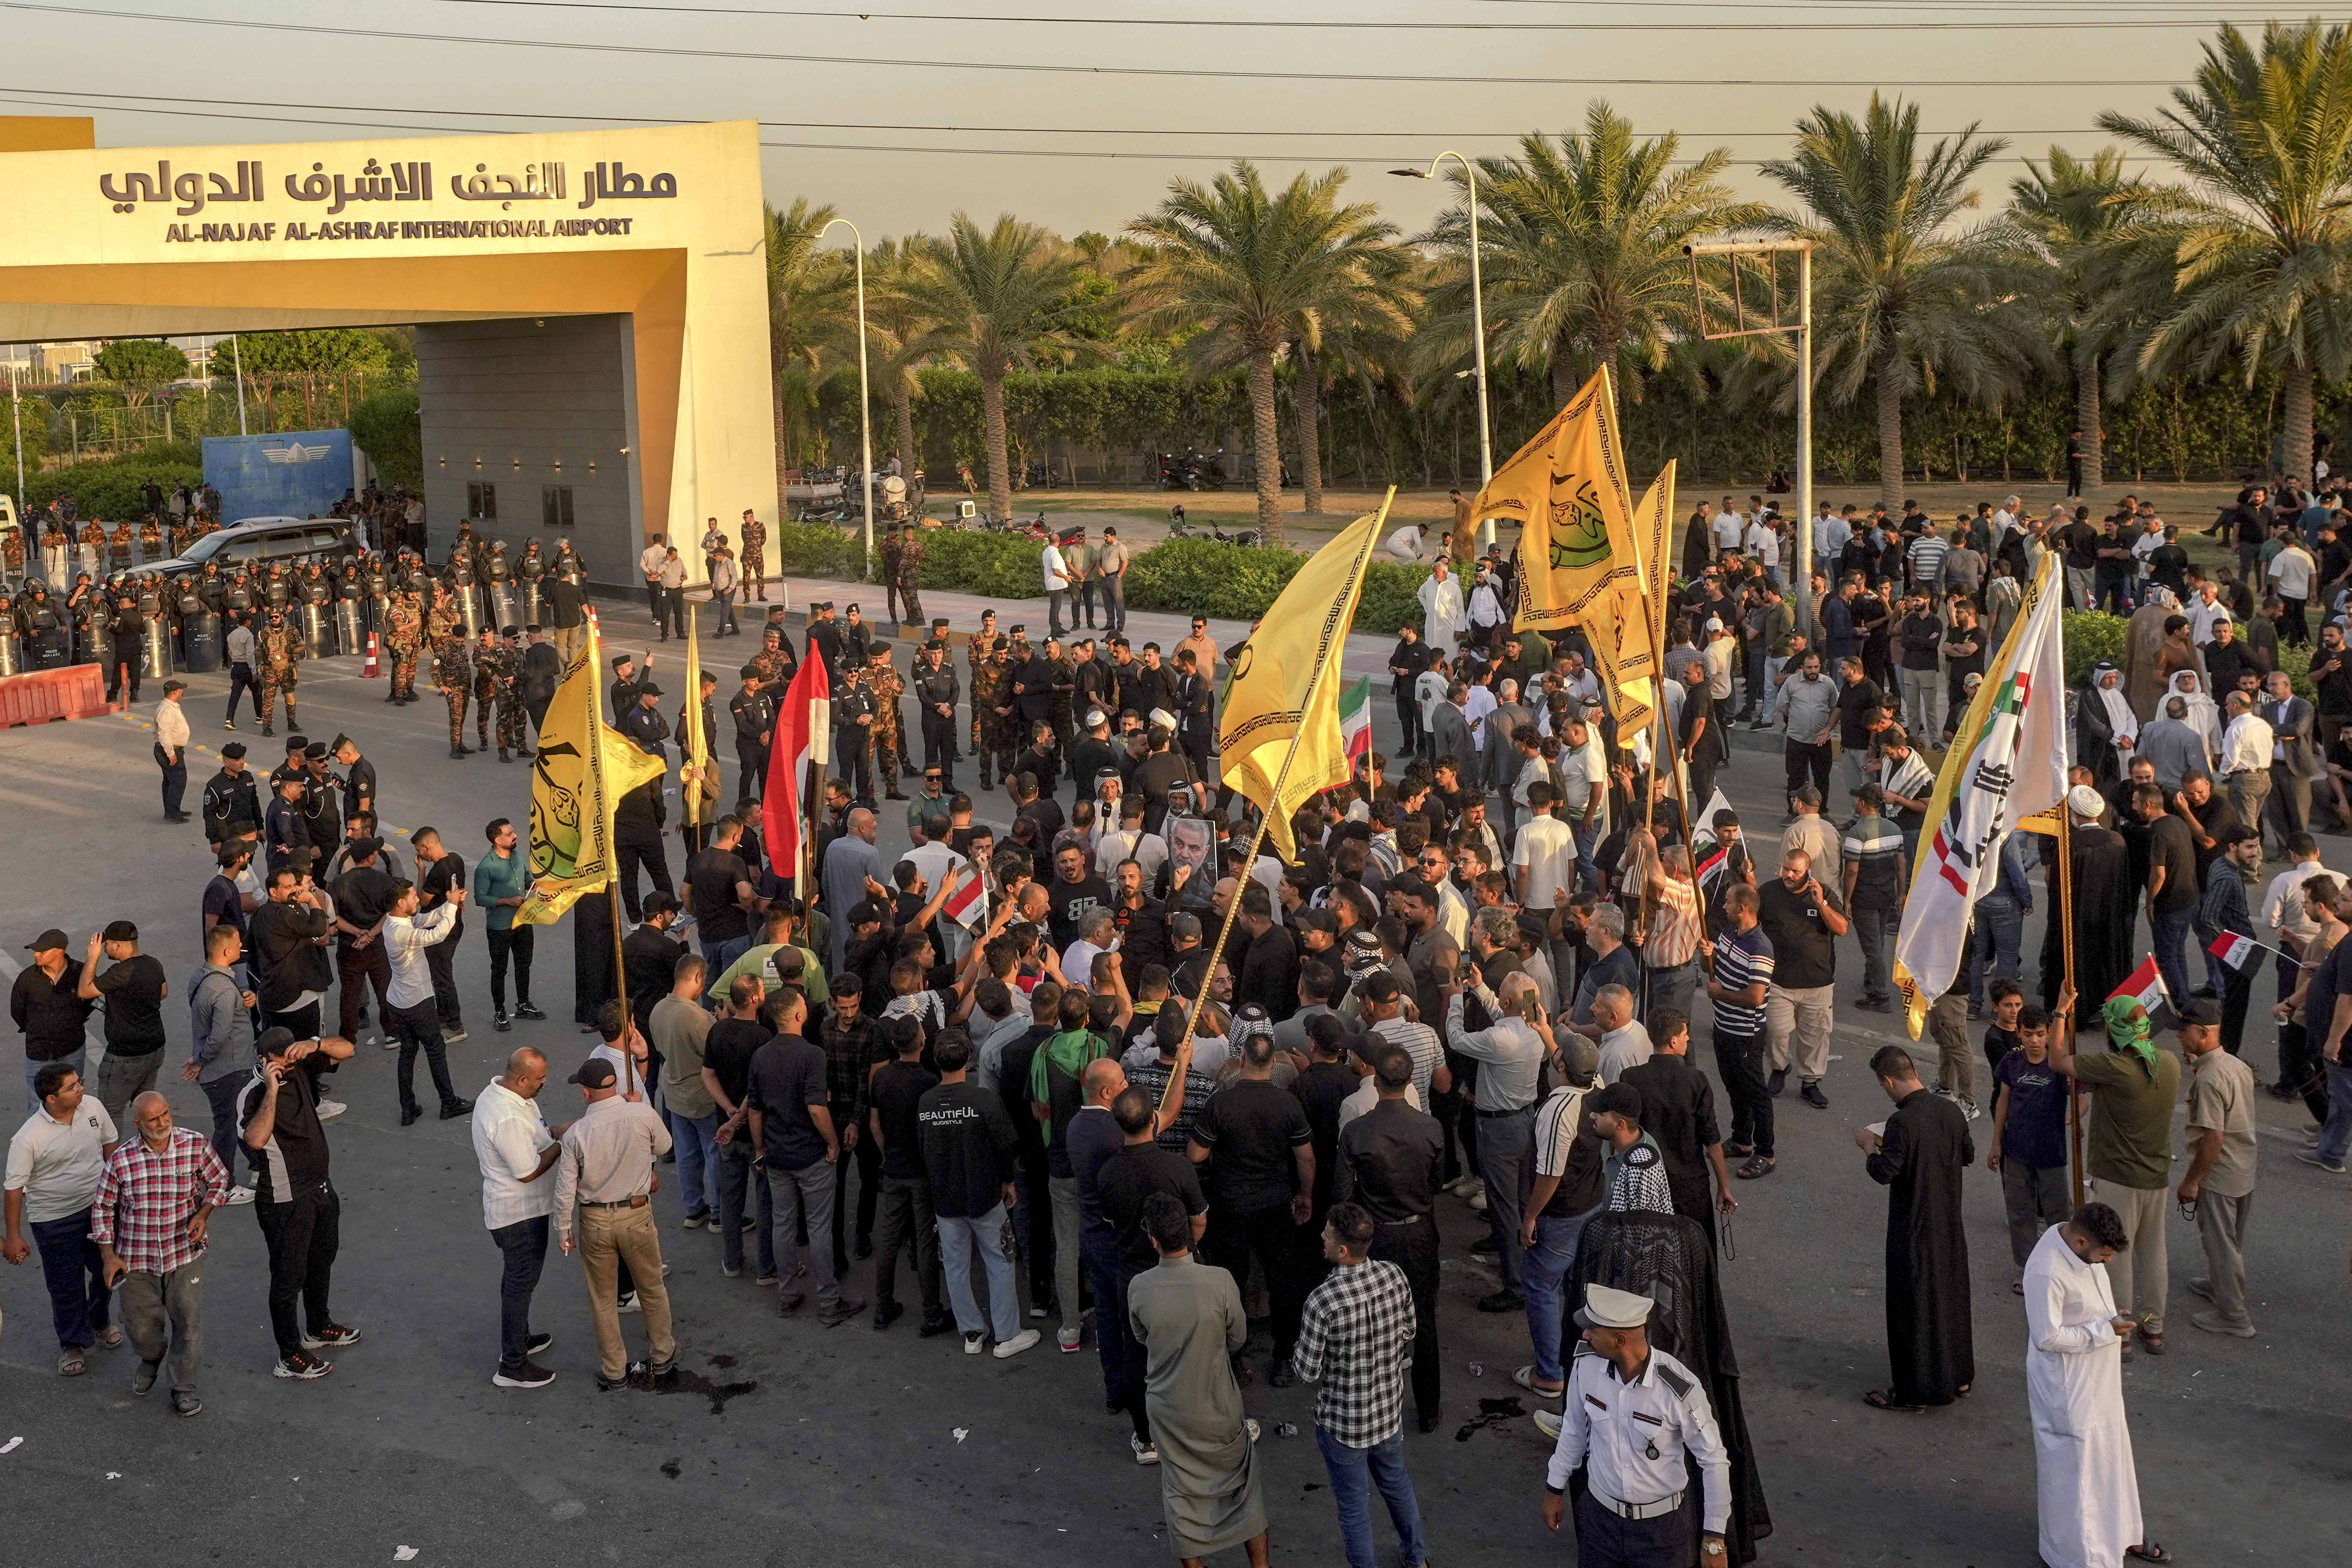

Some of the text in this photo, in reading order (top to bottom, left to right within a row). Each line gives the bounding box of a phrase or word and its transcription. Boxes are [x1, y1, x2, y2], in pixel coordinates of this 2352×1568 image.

[100, 158, 677, 216] مطار النجف الاشرف الدولي
[166, 218, 632, 242] AL-NAJAF AL-ASHRAF INTERNATIONAL AIRPORT
